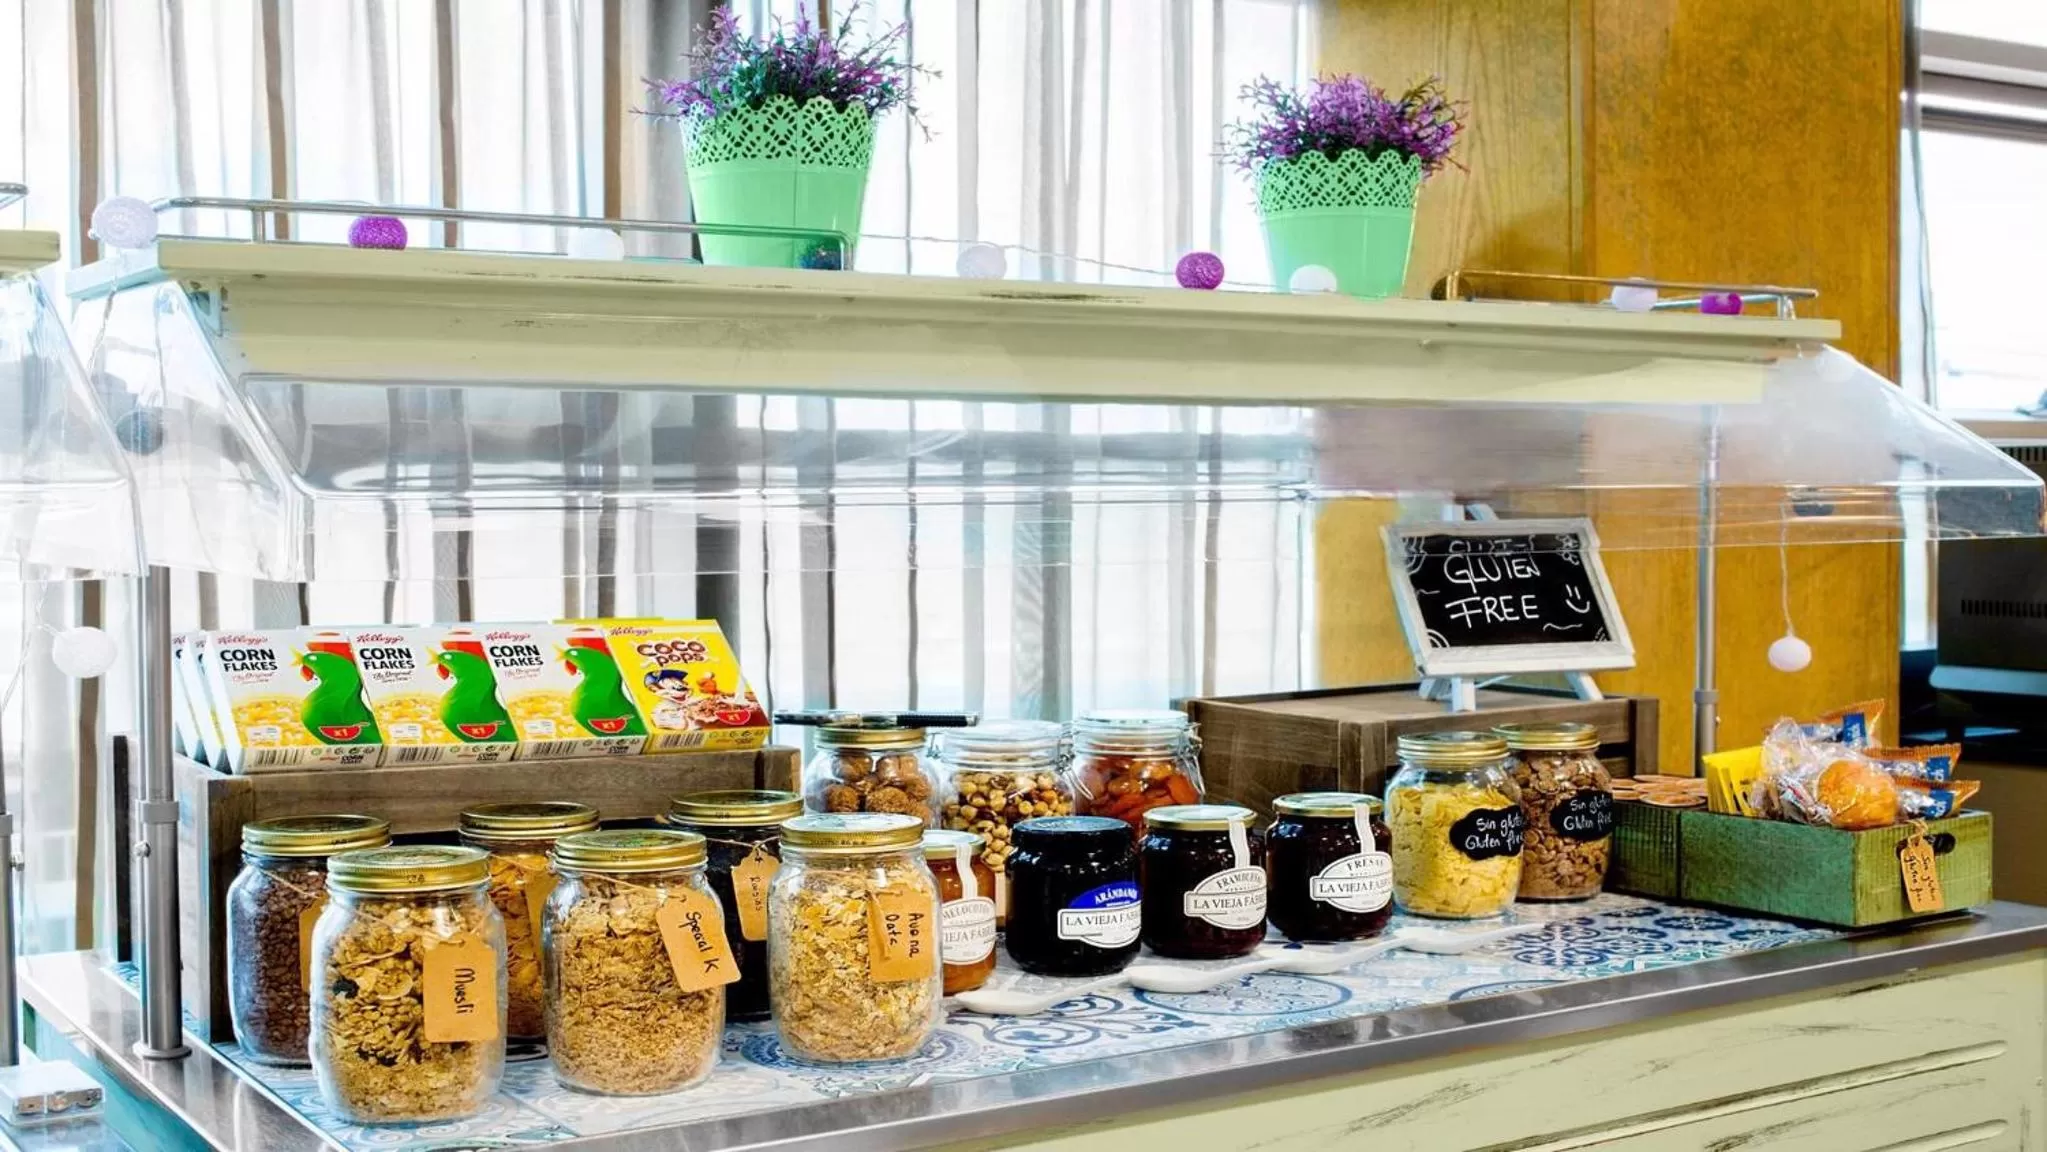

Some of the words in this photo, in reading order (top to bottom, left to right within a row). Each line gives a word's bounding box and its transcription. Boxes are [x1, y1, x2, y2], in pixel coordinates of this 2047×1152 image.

[1443, 552, 1541, 594] GLUTEN
[1445, 595, 1539, 629] FREE
[485, 632, 531, 642] Kellogg's
[610, 627, 653, 636] Kellogg's
[218, 635, 268, 646] Kellogg's
[357, 633, 404, 644] Kellogg's
[220, 649, 275, 661] CORN
[360, 648, 413, 660] CORN
[489, 645, 540, 658] CORN
[224, 661, 278, 672] FLAKES
[363, 660, 415, 670] FLAKES
[494, 657, 544, 668] FLAKES
[1570, 800, 1586, 812] Sin
[1476, 818, 1496, 832] Sin
[1563, 815, 1594, 831] Gluten
[1465, 833, 1501, 850] Gluten
[1319, 883, 1335, 893] LA
[1338, 882, 1368, 893] VIEJA
[1193, 899, 1210, 909] LA
[1212, 897, 1243, 909] VIEJA
[1066, 916, 1083, 926] LA
[1085, 914, 1118, 925] VIEJA
[945, 929, 969, 943] IEJA
[703, 957, 720, 974] K
[454, 968, 476, 1014] Muesli
